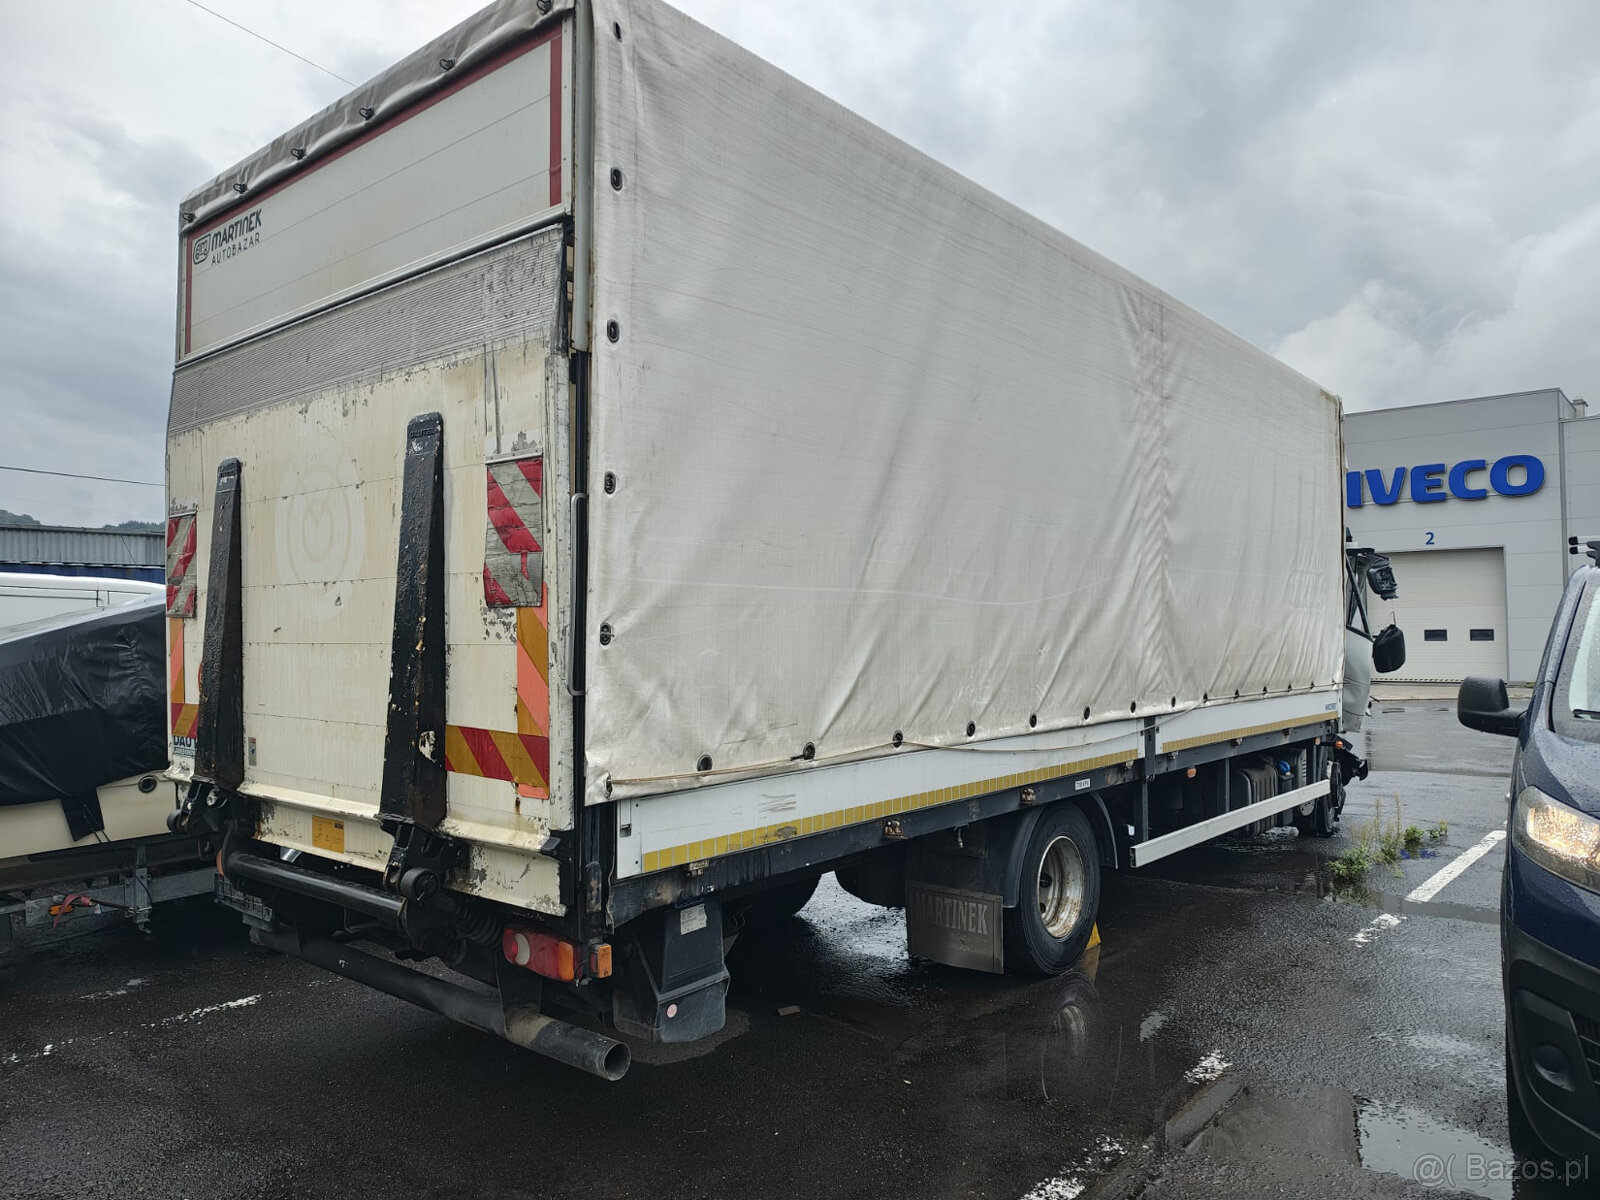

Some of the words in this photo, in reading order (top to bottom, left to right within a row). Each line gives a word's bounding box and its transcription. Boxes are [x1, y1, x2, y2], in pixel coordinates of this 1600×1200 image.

[211, 209, 262, 251] MARTINEK
[211, 232, 260, 266] AUTOBAZAR
[1346, 454, 1546, 508] IVECO
[1425, 532, 1435, 545] 2
[915, 892, 988, 936] MARTINEK
